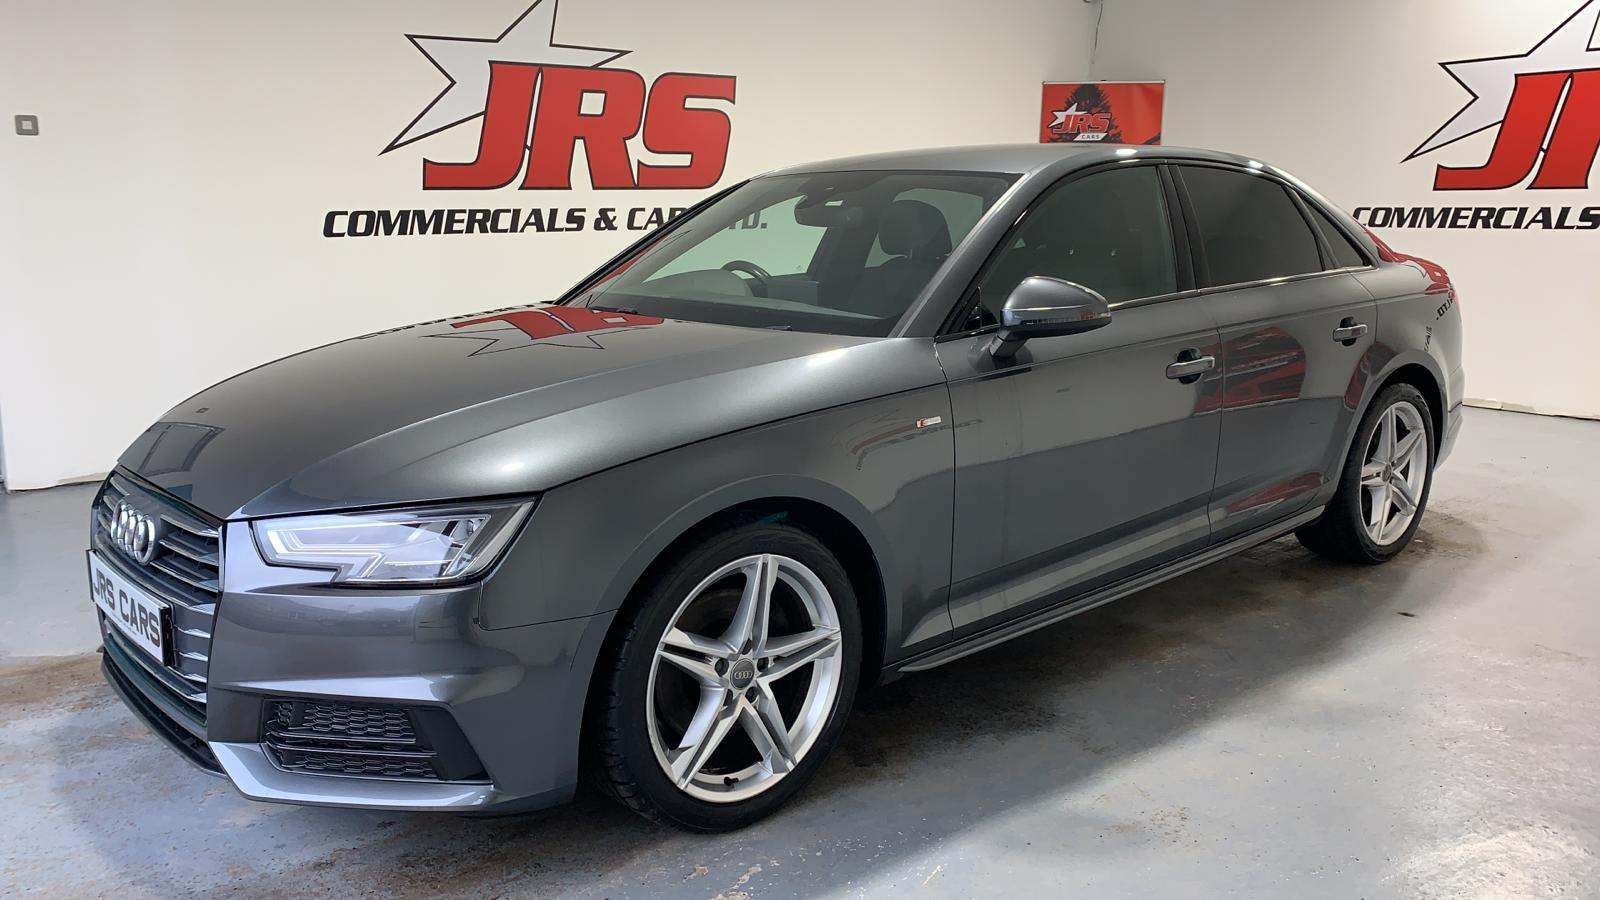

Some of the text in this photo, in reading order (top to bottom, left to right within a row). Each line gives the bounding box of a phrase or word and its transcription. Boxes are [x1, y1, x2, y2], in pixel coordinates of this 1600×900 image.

[423, 60, 737, 191] JRS
[1052, 112, 1112, 134] JRS
[323, 207, 584, 238] COMMERCIALS
[594, 207, 617, 231] &
[1352, 206, 1600, 231] COMMERCIALS
[94, 567, 115, 611] JRS
[119, 588, 161, 648] CARS
